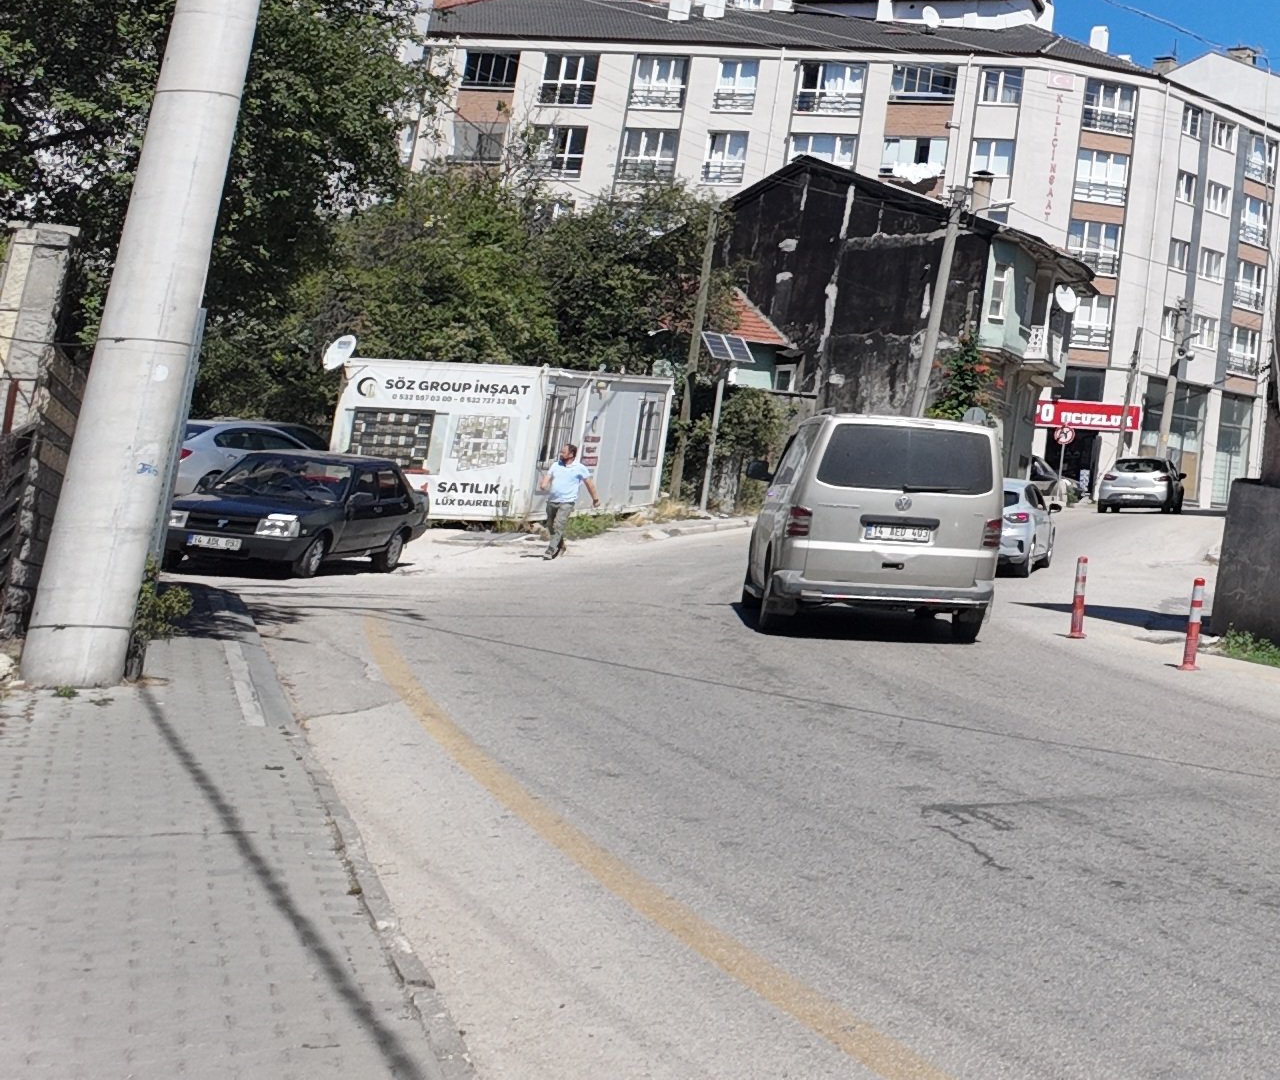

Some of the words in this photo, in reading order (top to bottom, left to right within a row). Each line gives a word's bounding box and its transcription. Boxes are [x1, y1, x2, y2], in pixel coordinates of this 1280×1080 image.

[384, 376, 416, 390] SÖZ
[418, 380, 472, 393] GROUP
[474, 379, 531, 397] İNŞAAT
[437, 481, 500, 495] SATILIK
